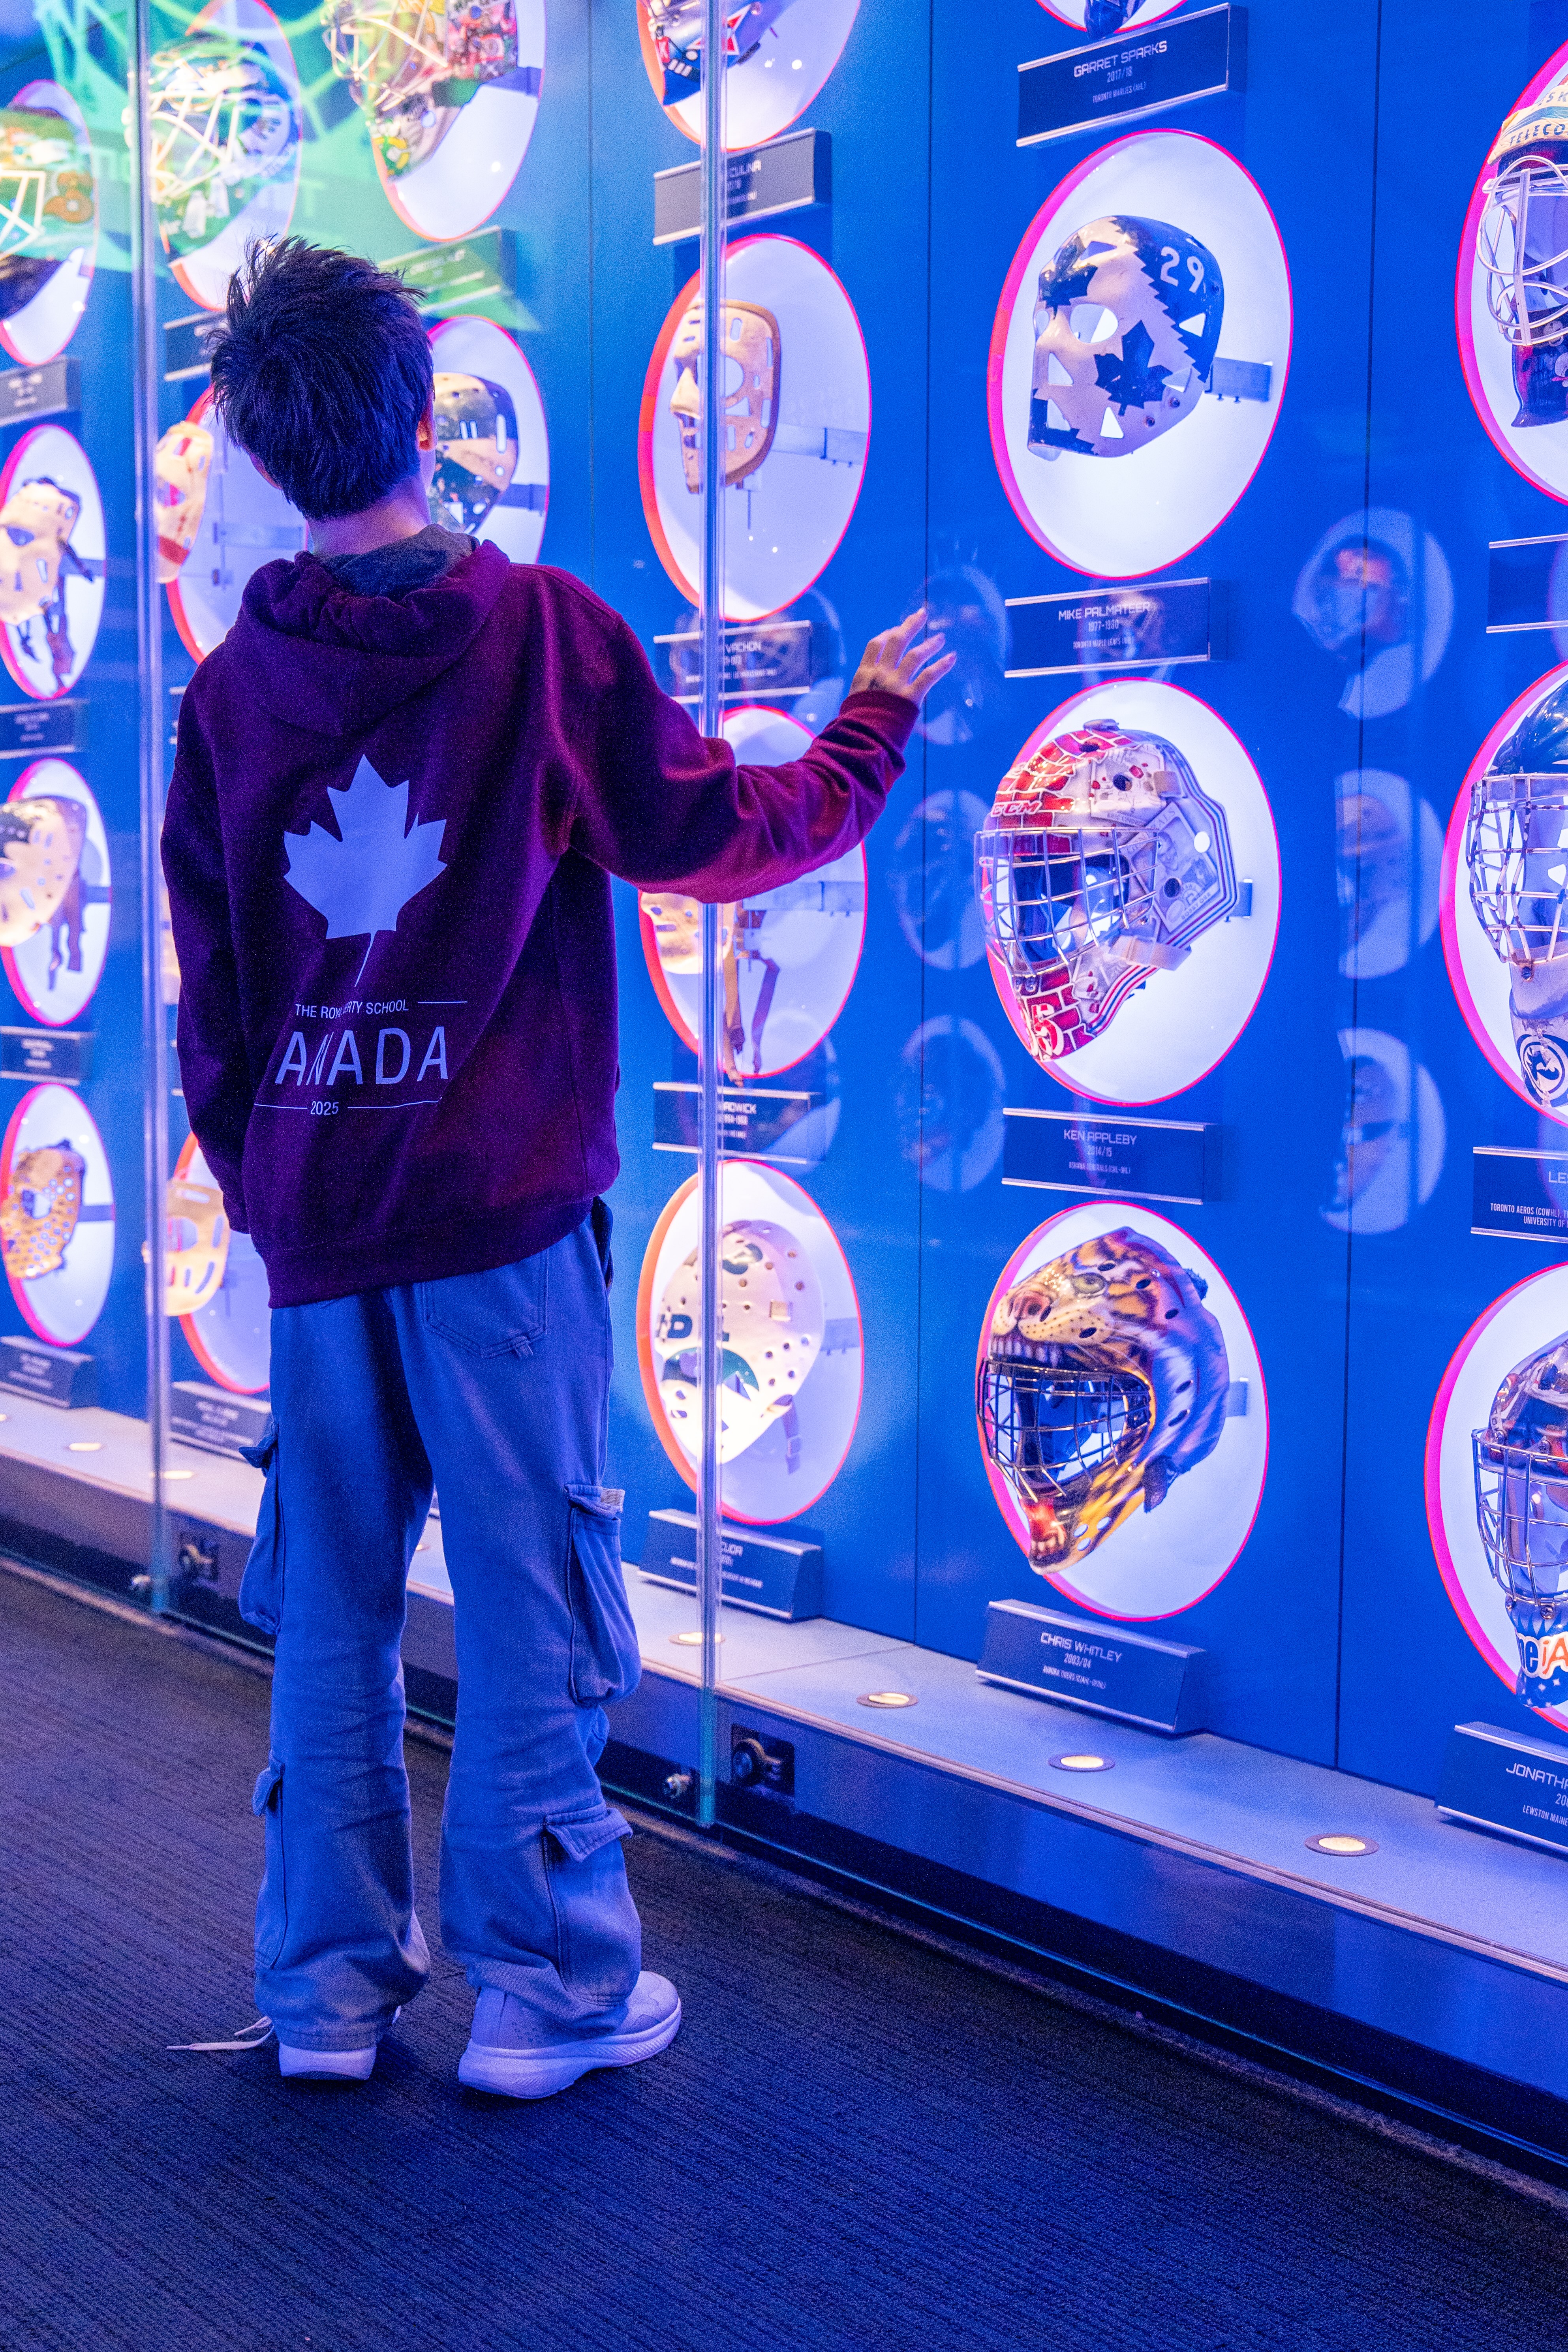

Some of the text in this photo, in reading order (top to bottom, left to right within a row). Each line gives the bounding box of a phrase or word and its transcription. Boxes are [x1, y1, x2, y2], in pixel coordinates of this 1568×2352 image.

[1074, 40, 1168, 77] GARRET SPARKS
[1107, 66, 1133, 83] 2017/18
[1510, 124, 1568, 146] TELECO
[1160, 246, 1205, 293] 29
[1058, 601, 1150, 621] MIKE PALMATEER
[991, 801, 1042, 817] CCM
[295, 1003, 317, 1017] THE
[366, 999, 409, 1015] SCHOOL
[274, 1026, 448, 1086] ANADA
[310, 1100, 339, 1115] 2025
[1064, 1129, 1137, 1145] KEN APPLEBY
[1087, 1145, 1112, 1157] 2014/15
[1548, 1170, 1568, 1184] LE
[1490, 1203, 1515, 1213] TORONTO
[1516, 1205, 1534, 1215] AEROS
[1523, 1216, 1565, 1228] UNIVERSITY OF
[1040, 1632, 1123, 1663] CHRIS WHITLEY
[1064, 1652, 1092, 1669] 2003/04
[1523, 1804, 1568, 1826] LEWSTON MAINE
